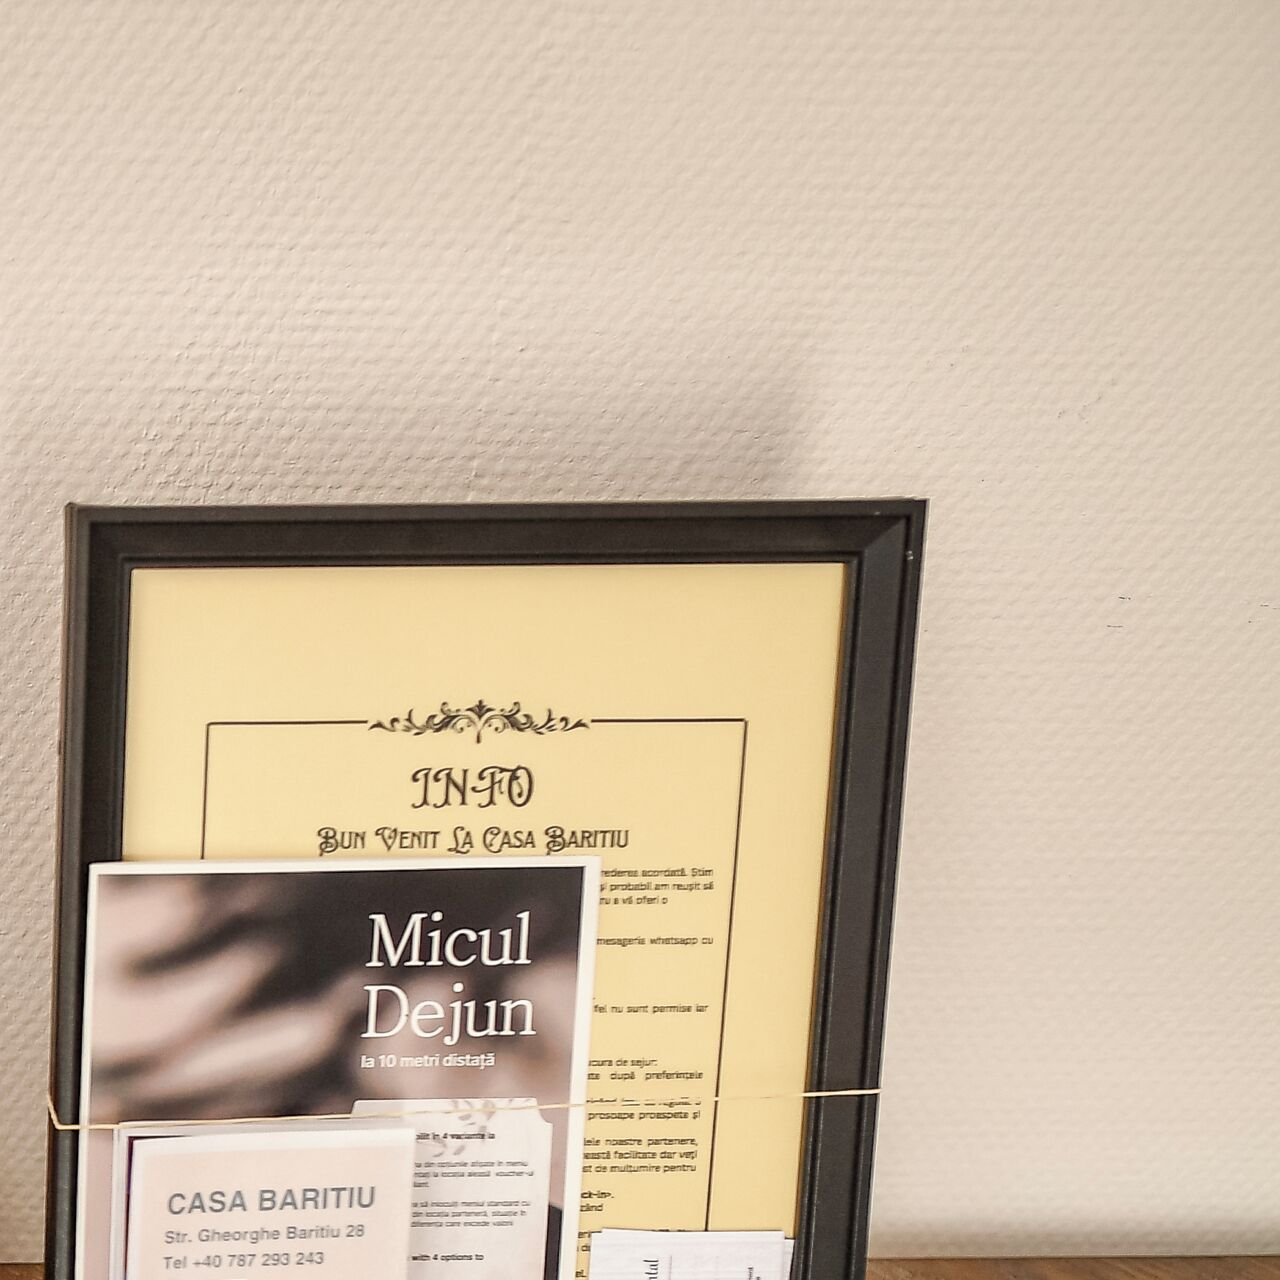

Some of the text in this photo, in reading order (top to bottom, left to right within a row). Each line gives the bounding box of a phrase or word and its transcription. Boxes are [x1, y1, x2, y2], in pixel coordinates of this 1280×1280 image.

[412, 766, 535, 808] INFO
[365, 911, 532, 967] Micul
[650, 936, 698, 945] whatsapp
[361, 982, 537, 1045] Dejun
[361, 1054, 375, 1068] la
[379, 1054, 396, 1067] 10
[399, 1053, 439, 1067] metri
[168, 1186, 376, 1214] CASA BARITIU
[165, 1225, 365, 1244] Str. Gheorghe Baritiu 28
[163, 1252, 324, 1269] Tel +40 787 293 243
